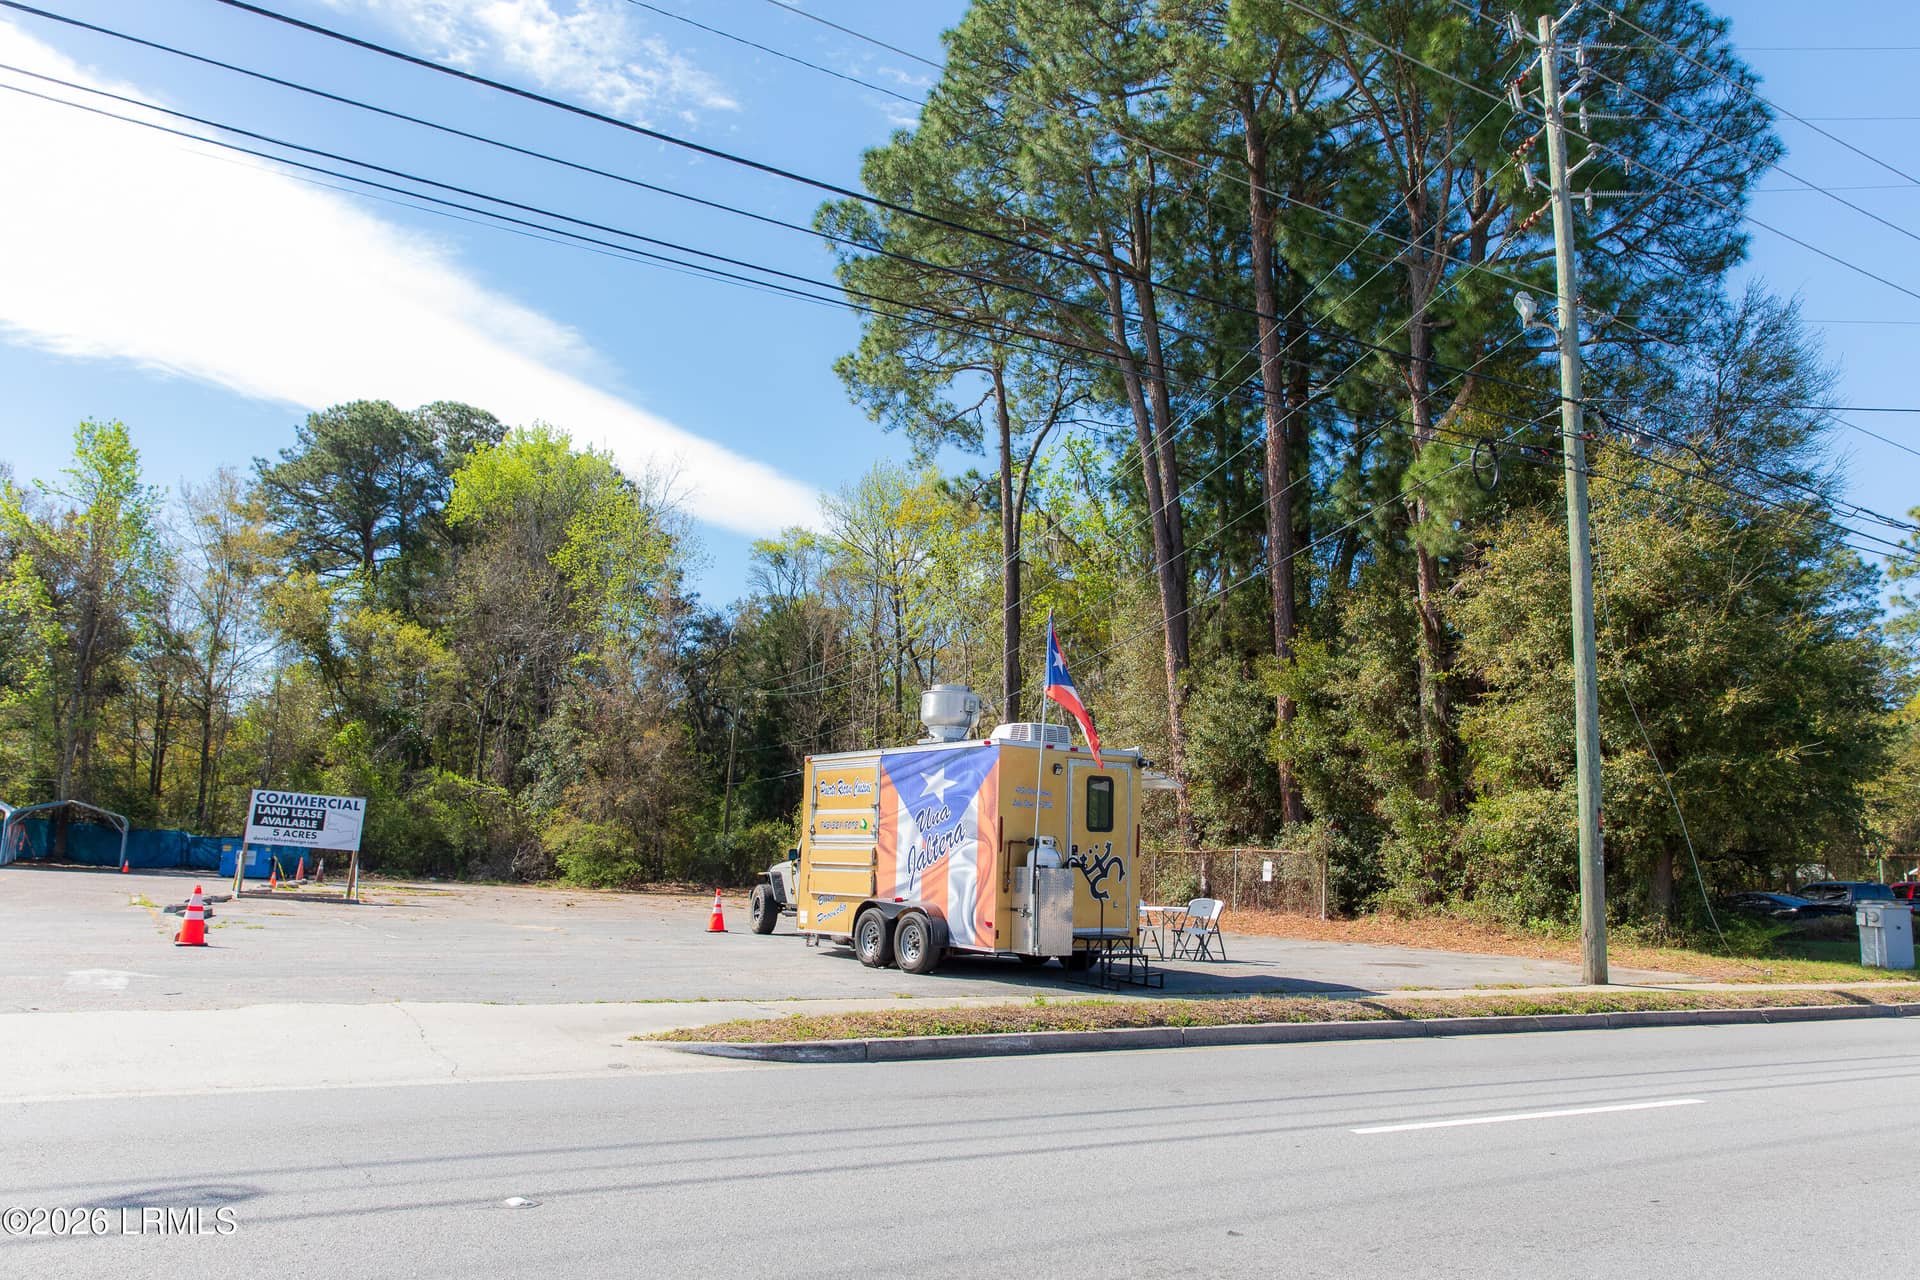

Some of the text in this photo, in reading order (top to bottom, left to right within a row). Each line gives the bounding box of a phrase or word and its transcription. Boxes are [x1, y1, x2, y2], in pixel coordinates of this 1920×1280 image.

[256, 792, 361, 811] COMMERCIAL
[257, 806, 324, 819] LAND LEASE
[915, 804, 951, 833] Una
[260, 816, 318, 829] AVAILABLE
[283, 830, 318, 840] ACRES
